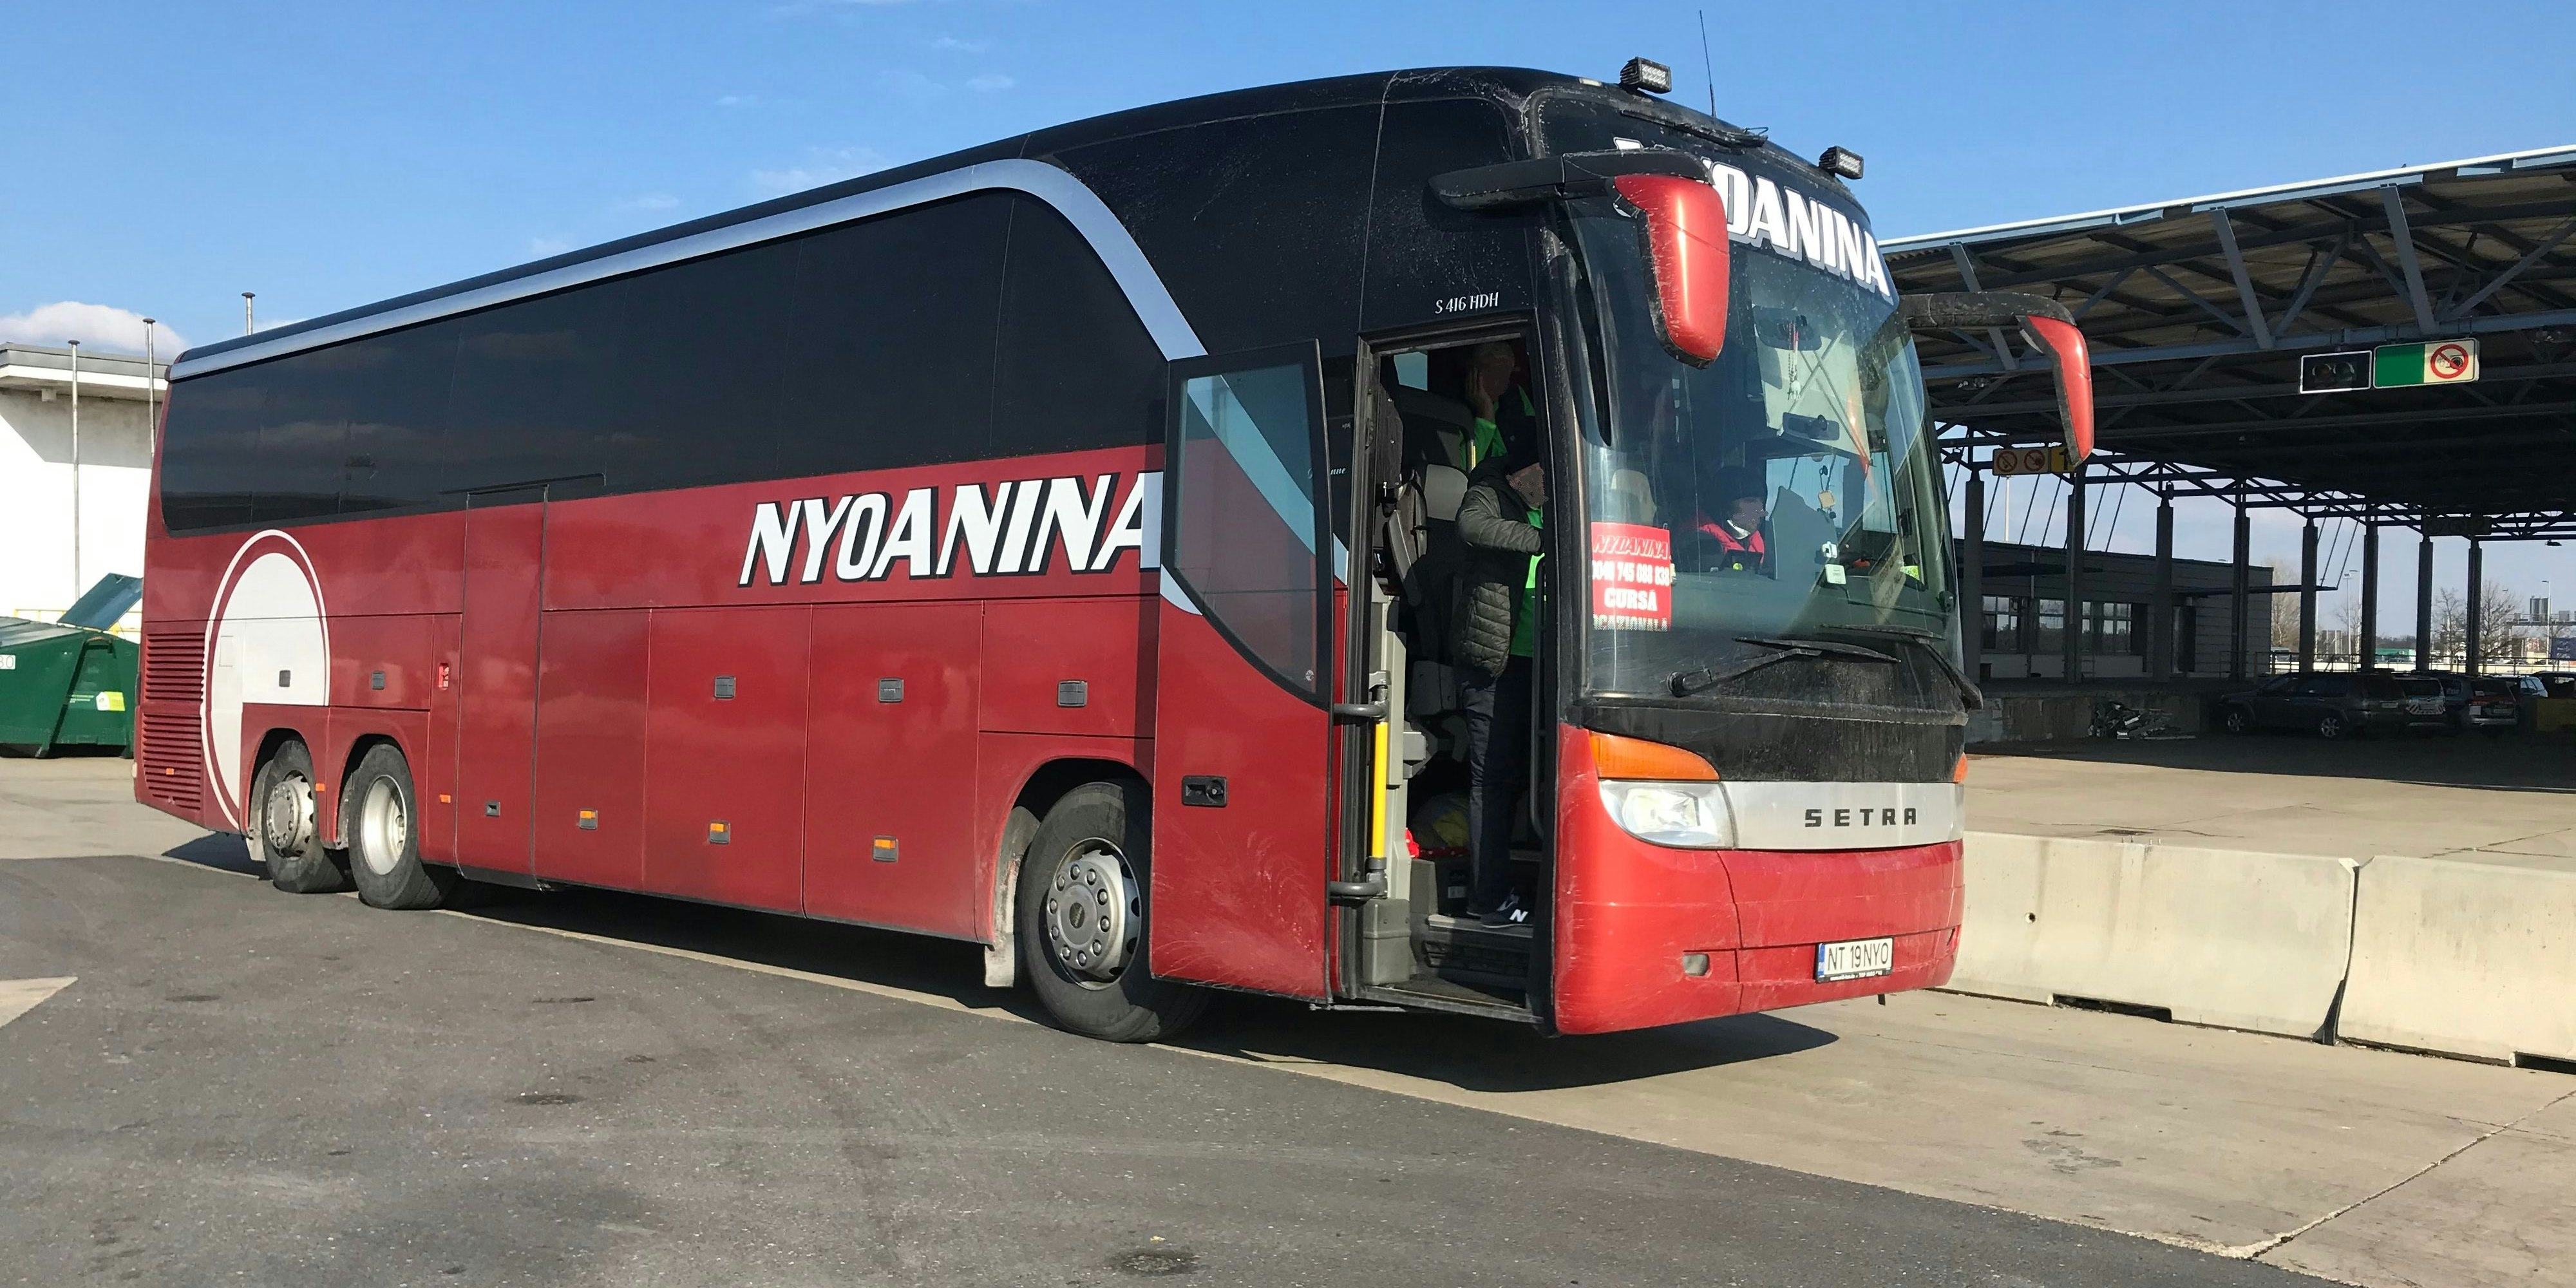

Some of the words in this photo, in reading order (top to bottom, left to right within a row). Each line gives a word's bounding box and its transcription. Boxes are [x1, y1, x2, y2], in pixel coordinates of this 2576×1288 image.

[1434, 299, 1443, 314] S
[1445, 296, 1467, 312] 416
[1469, 291, 1499, 310] HDH
[739, 471, 1164, 587] NYOANINA
[1617, 562, 1635, 582] 745
[1804, 808, 1917, 828] SETRA
[1509, 909, 1529, 922] N
[1828, 947, 1846, 971] NT
